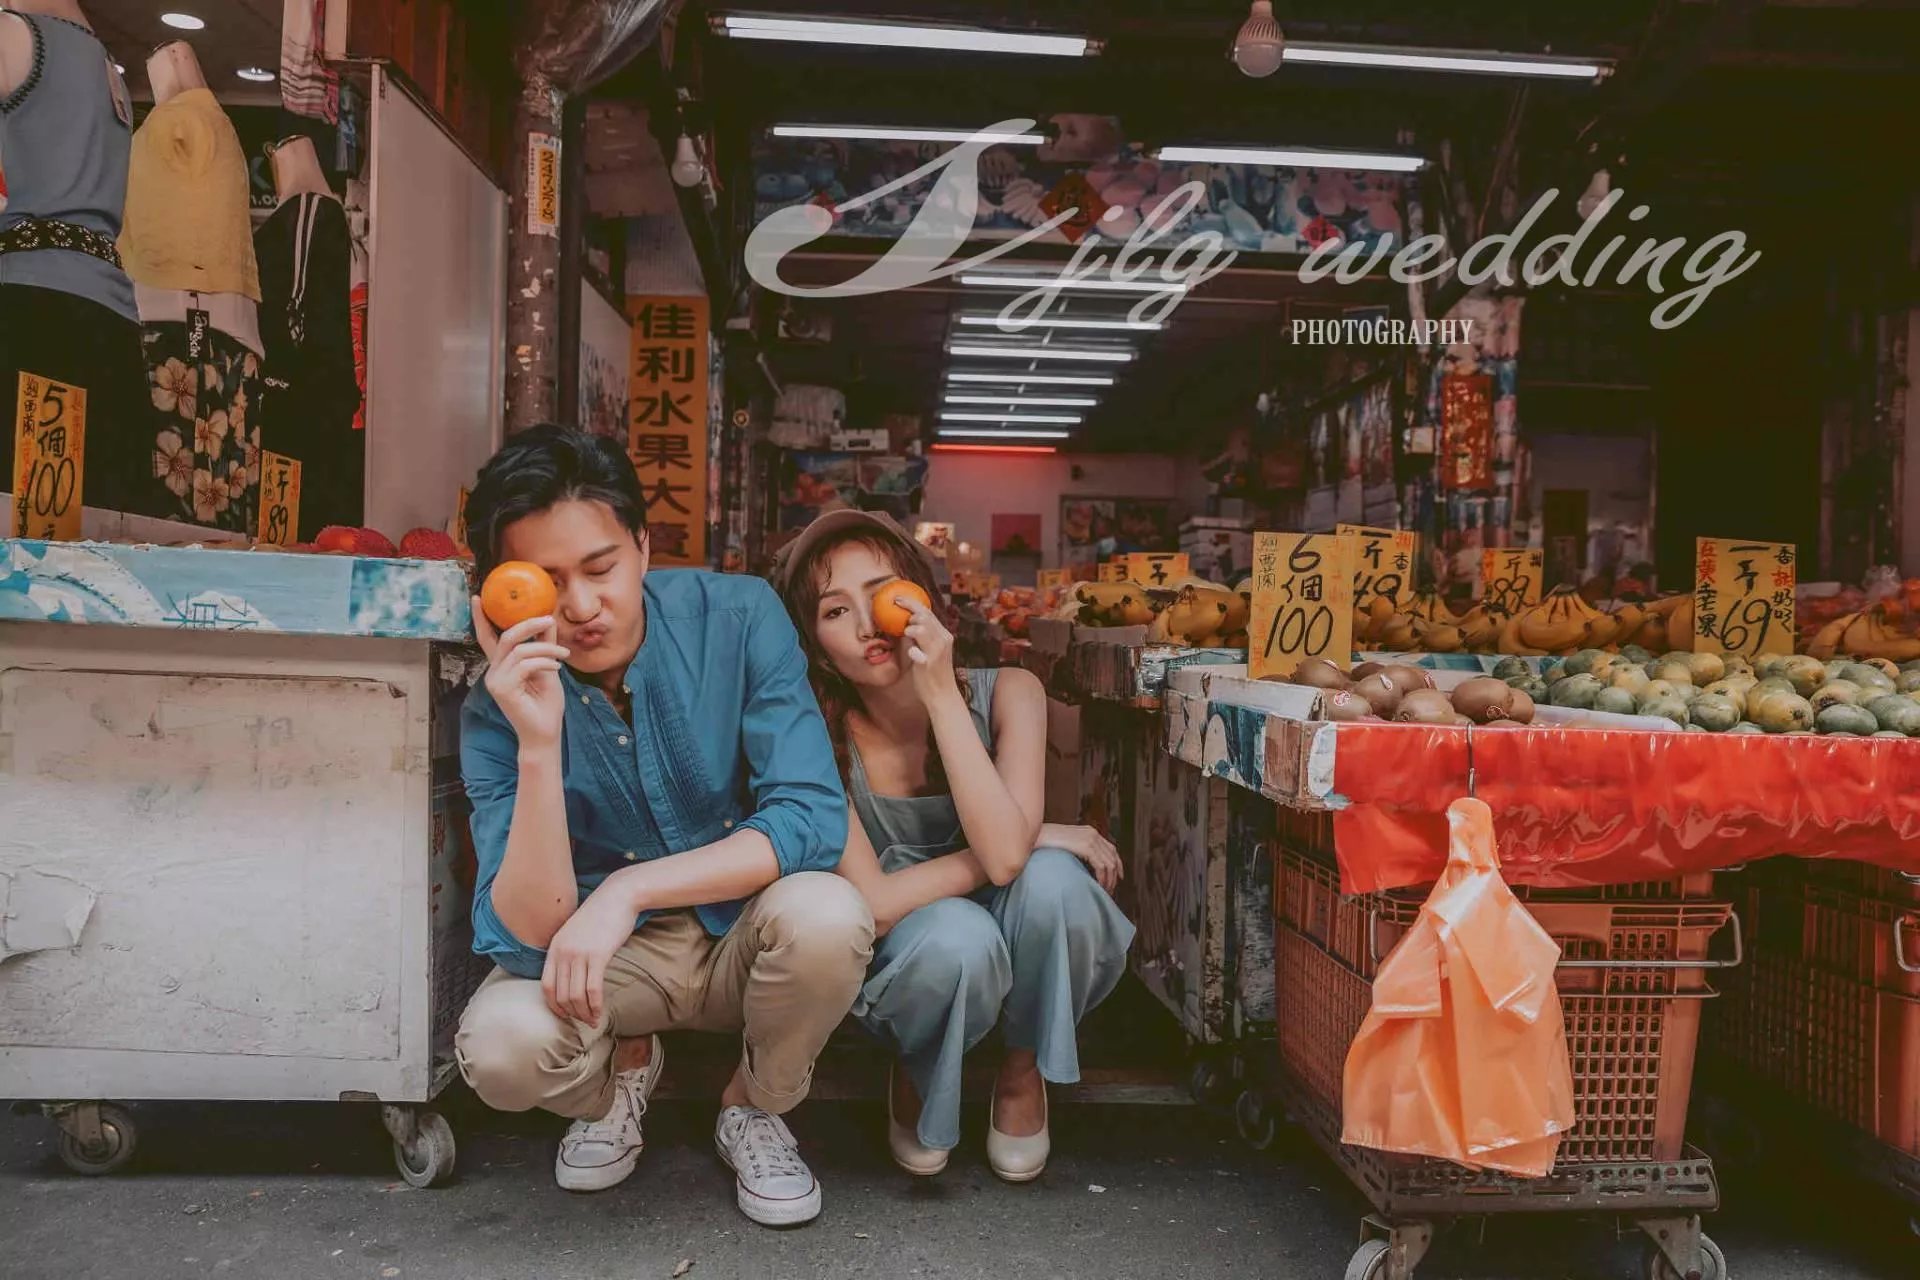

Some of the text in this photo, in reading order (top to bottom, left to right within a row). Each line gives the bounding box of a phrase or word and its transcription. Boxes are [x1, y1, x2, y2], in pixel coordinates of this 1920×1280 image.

[26, 458, 75, 517] 100
[267, 504, 288, 545] 89
[1264, 604, 1334, 658] 100
[1721, 599, 1773, 657] 69
